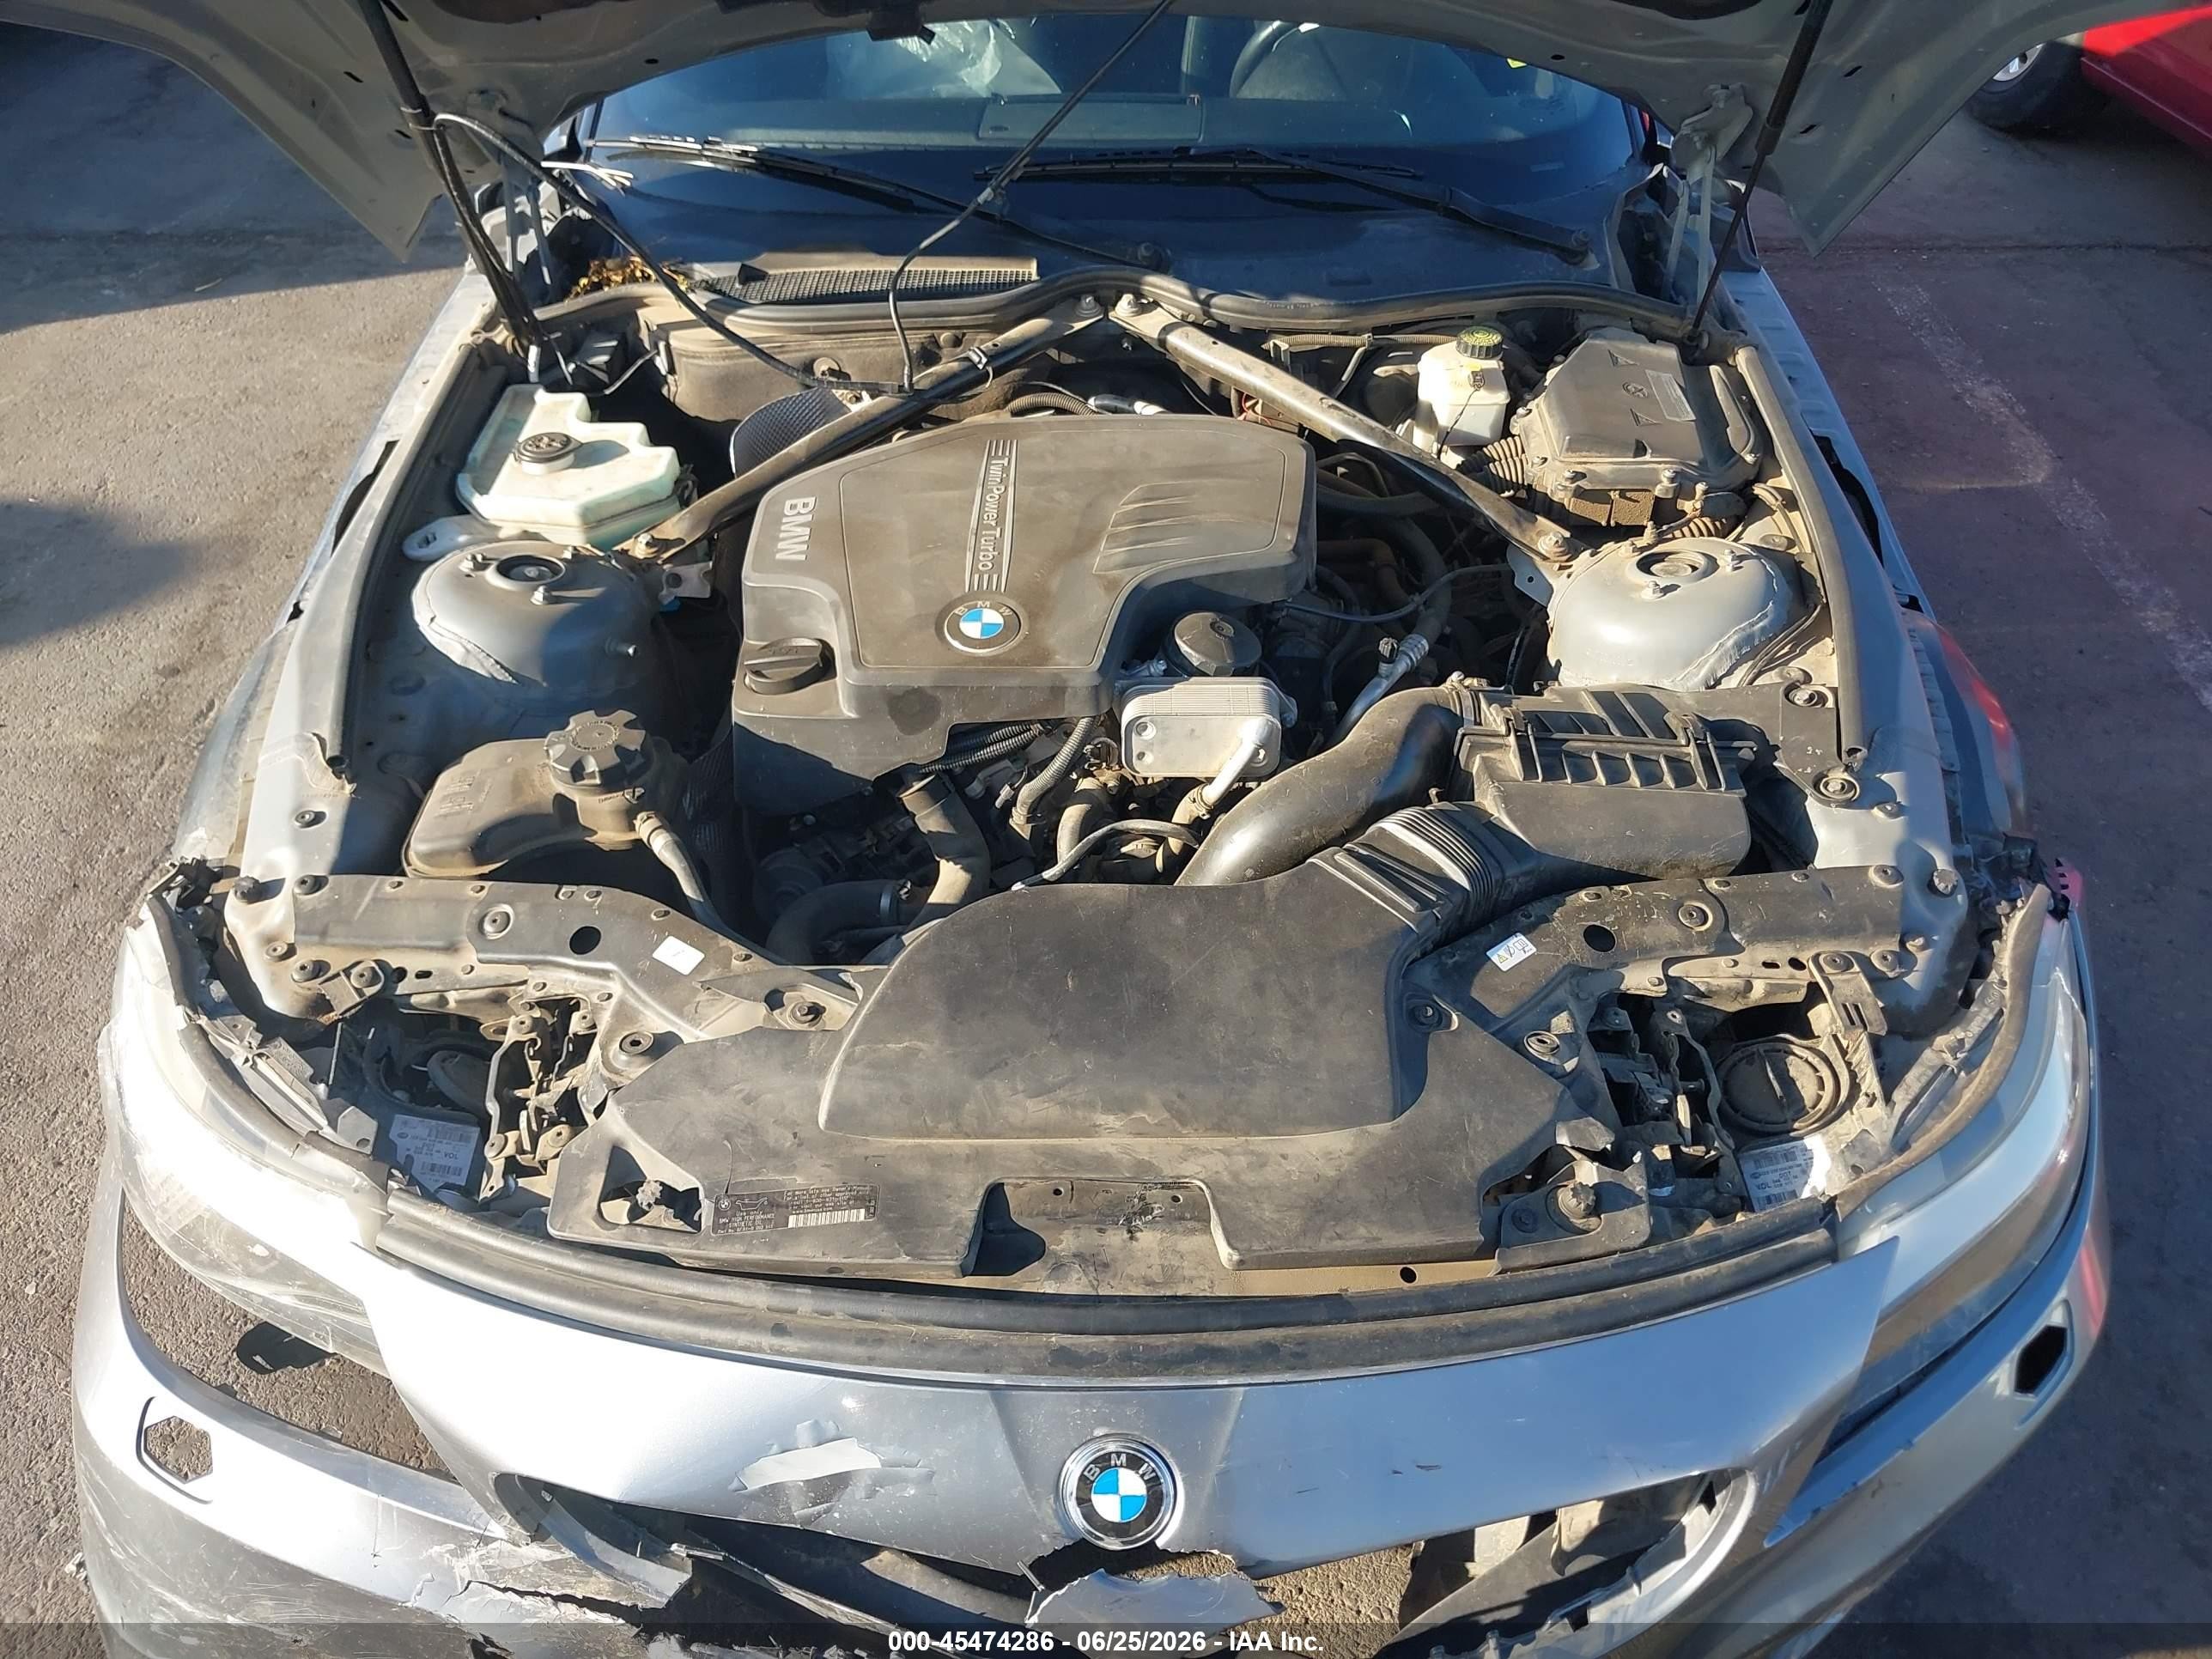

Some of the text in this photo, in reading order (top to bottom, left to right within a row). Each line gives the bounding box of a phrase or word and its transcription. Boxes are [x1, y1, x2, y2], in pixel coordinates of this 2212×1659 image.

[978, 457, 1010, 571] TwinPower Turbo
[775, 496, 817, 561] BMW
[954, 600, 1013, 617] BMW
[444, 1151, 460, 1160] VOL
[744, 1212, 775, 1221] PERFORMANCE
[1084, 1453, 1157, 1482] BMW
